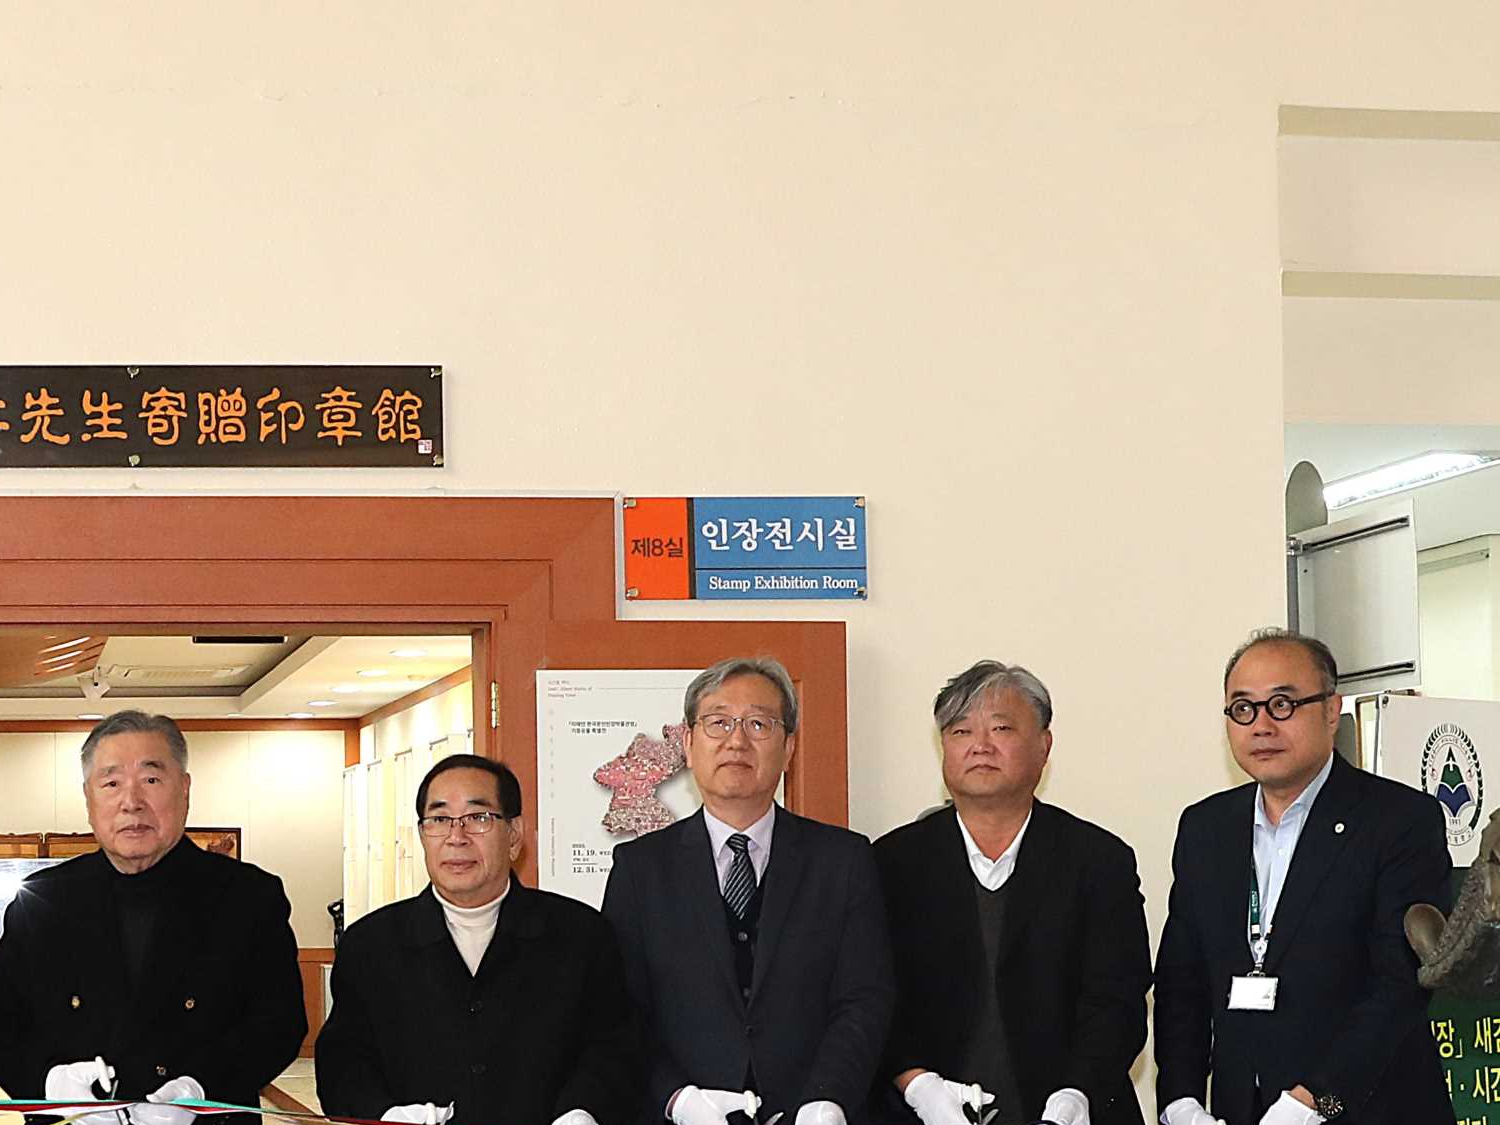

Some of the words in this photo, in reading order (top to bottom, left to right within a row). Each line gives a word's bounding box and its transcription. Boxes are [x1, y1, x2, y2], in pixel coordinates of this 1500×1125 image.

[701, 517, 857, 551] 인장전시실
[631, 537, 684, 558] 제8실
[709, 576, 751, 592] Stamp
[754, 576, 819, 590] Exhibition
[823, 576, 858, 589] Room
